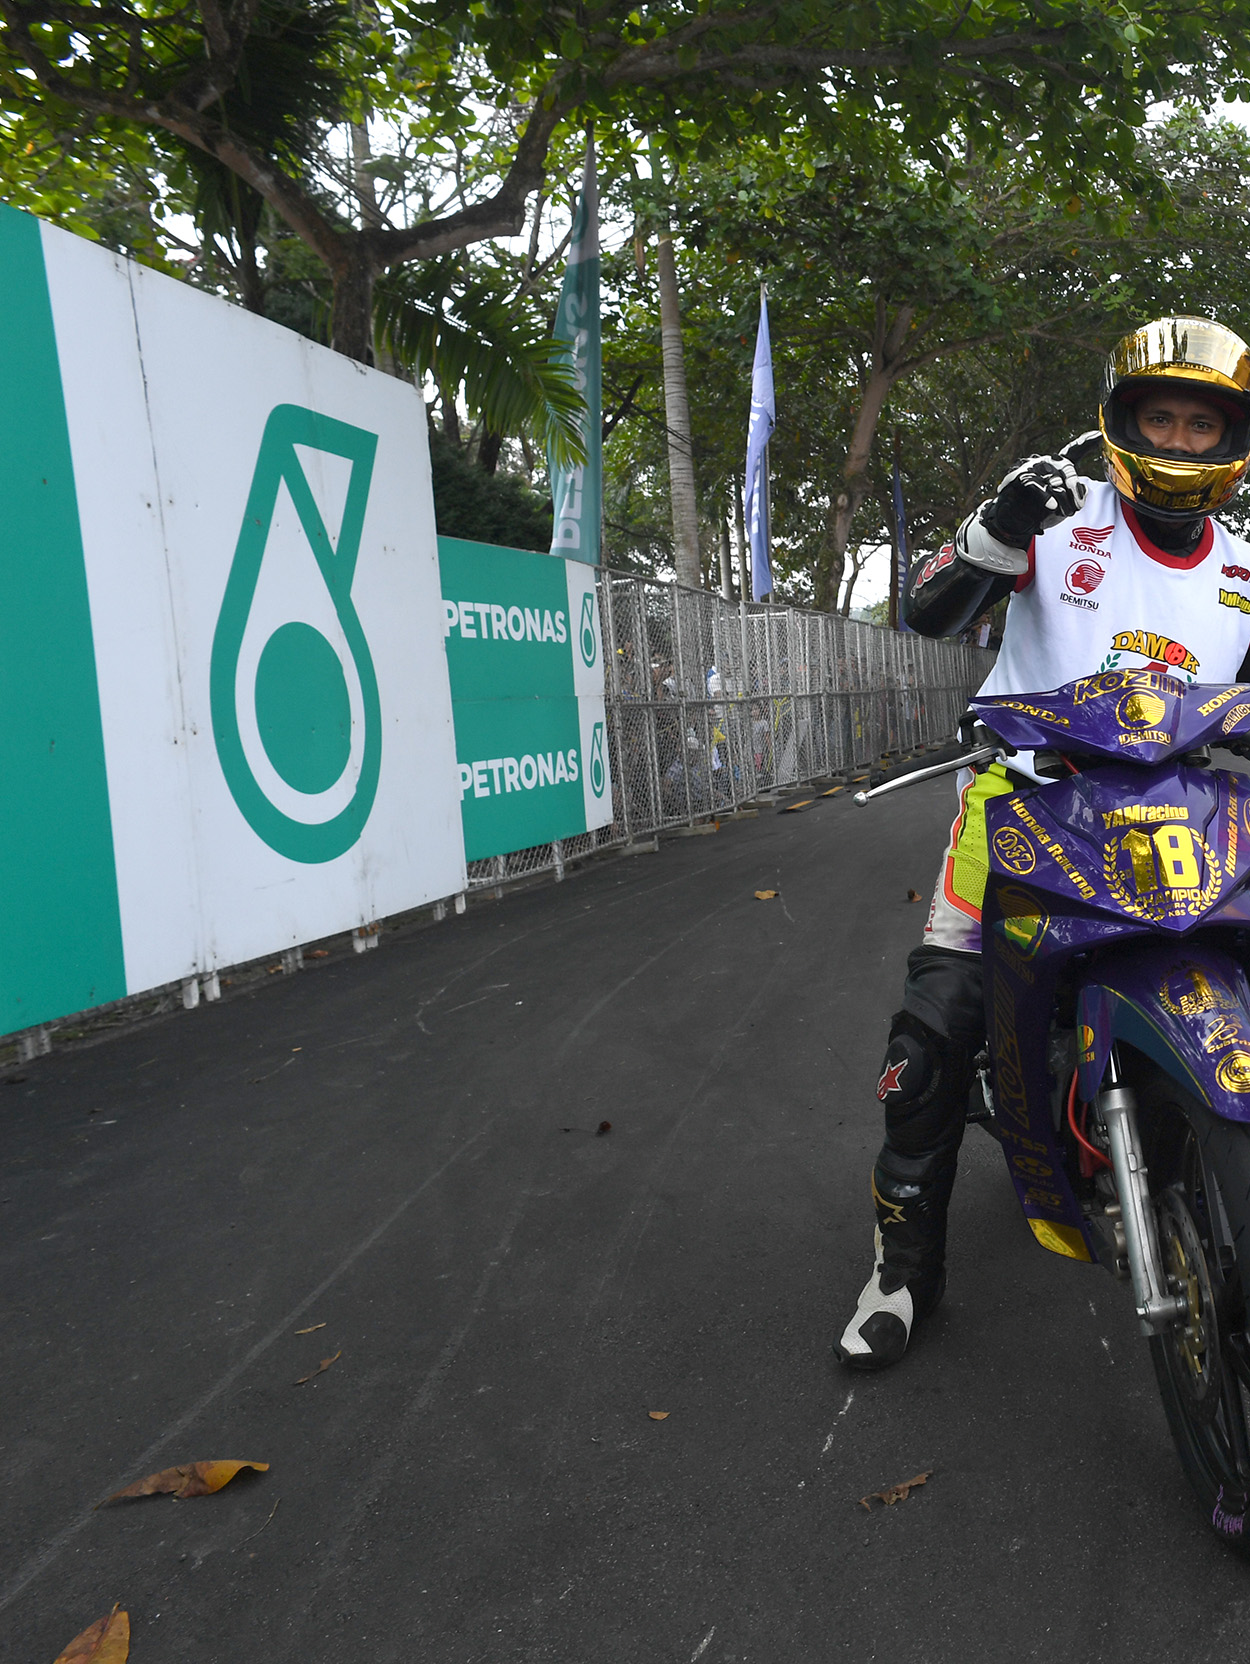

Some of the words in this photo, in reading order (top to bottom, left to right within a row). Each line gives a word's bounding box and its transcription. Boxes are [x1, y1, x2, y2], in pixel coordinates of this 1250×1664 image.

[1069, 541, 1112, 560] HONDA
[1060, 592, 1099, 610] IDEMITSU
[442, 600, 567, 644] PETRONAS
[992, 700, 1072, 729] HONDA
[1197, 686, 1248, 717] HONDA
[1118, 730, 1172, 744] IDEMITSU
[457, 749, 579, 801] PETRONAS
[1102, 804, 1189, 830] YAMracing
[1008, 797, 1051, 845] Honda
[1047, 843, 1096, 900] Racing
[1121, 825, 1200, 894] 18
[1224, 820, 1238, 878] Honda
[1134, 889, 1211, 909] CHAMPION
[1168, 909, 1187, 917] KBS
